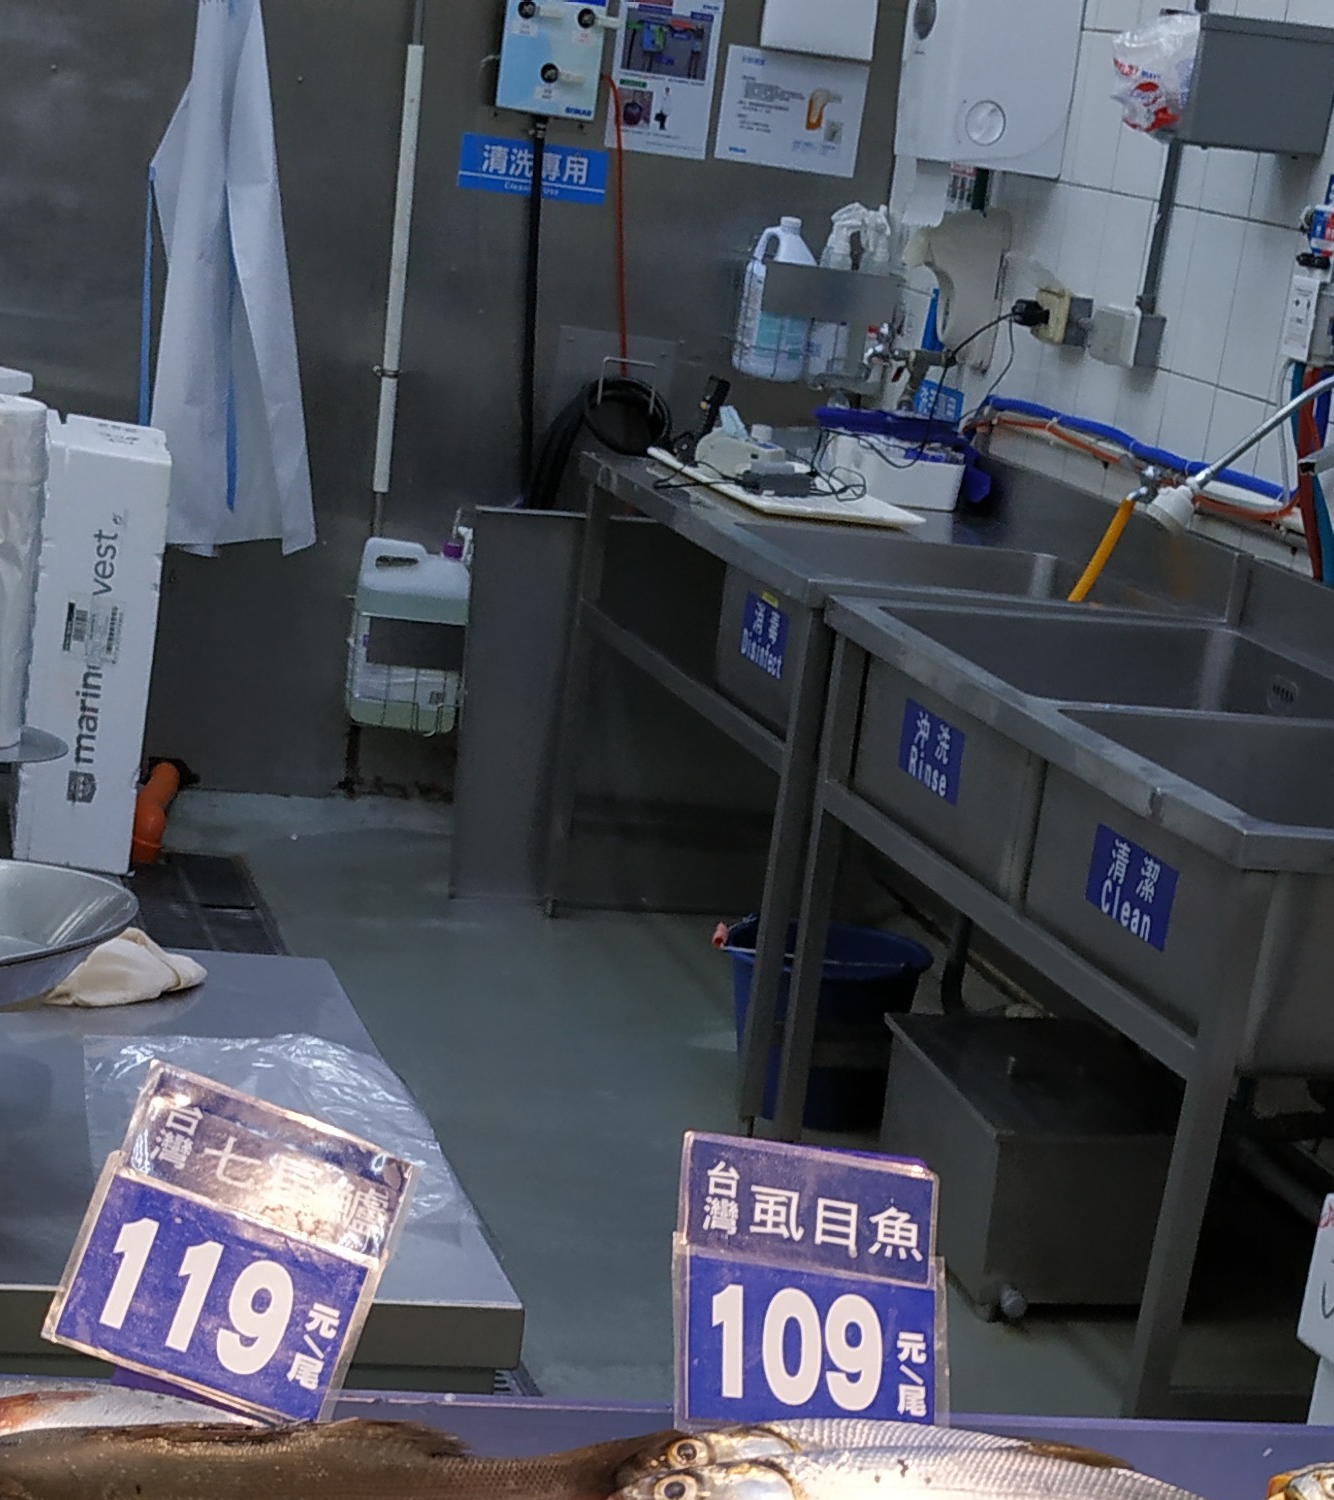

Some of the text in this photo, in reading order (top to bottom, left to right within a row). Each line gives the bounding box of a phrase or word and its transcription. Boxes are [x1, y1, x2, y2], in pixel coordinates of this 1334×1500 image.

[482, 144, 588, 184] 清洗專用
[740, 627, 782, 680] Disinfect
[908, 744, 947, 797] Rinse
[1107, 838, 1161, 904] 清潔
[1101, 879, 1151, 942] Clean
[150, 1104, 204, 1171] 台灣
[703, 1160, 924, 1262] 台灣 虱目魚
[99, 1217, 294, 1375] 119
[712, 1284, 883, 1411] 109
